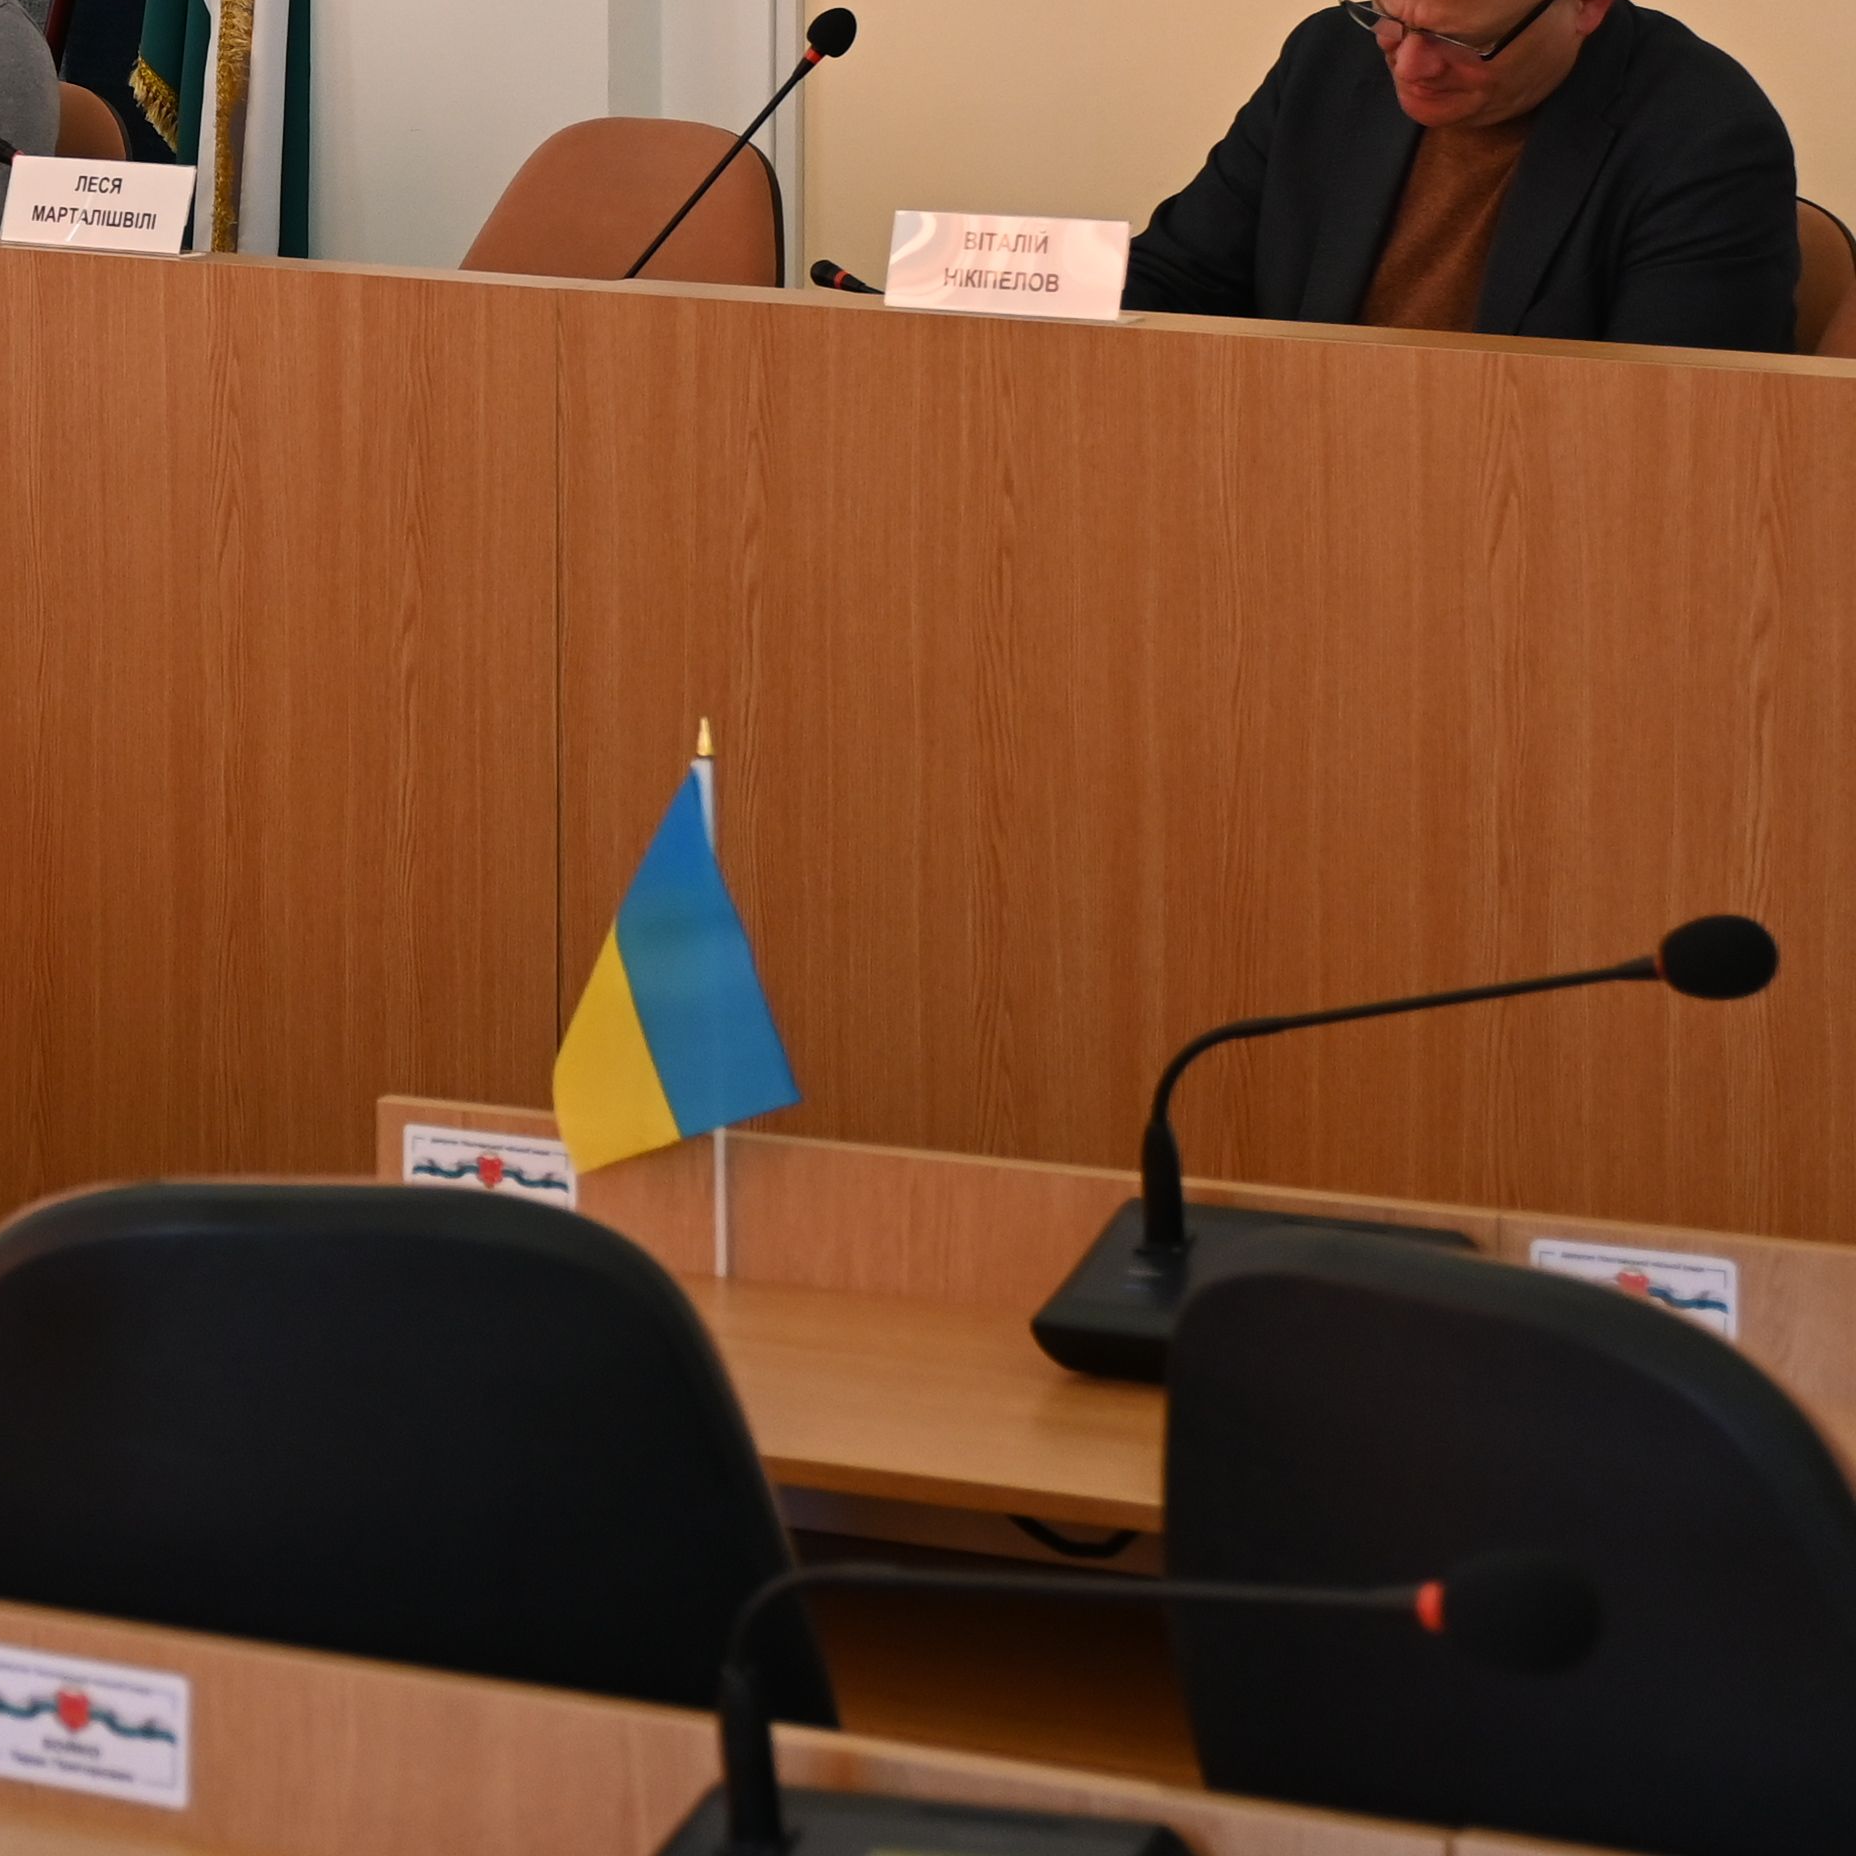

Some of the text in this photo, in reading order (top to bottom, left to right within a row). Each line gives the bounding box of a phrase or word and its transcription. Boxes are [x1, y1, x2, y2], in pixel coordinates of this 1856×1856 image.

[75, 175, 123, 194] ЛЕСЯ
[31, 205, 157, 230] МАРТАЛІШВІЛІ
[964, 230, 1050, 254] ВІТАЛІЙ
[943, 267, 1060, 293] НІКІПЕЛОВ
